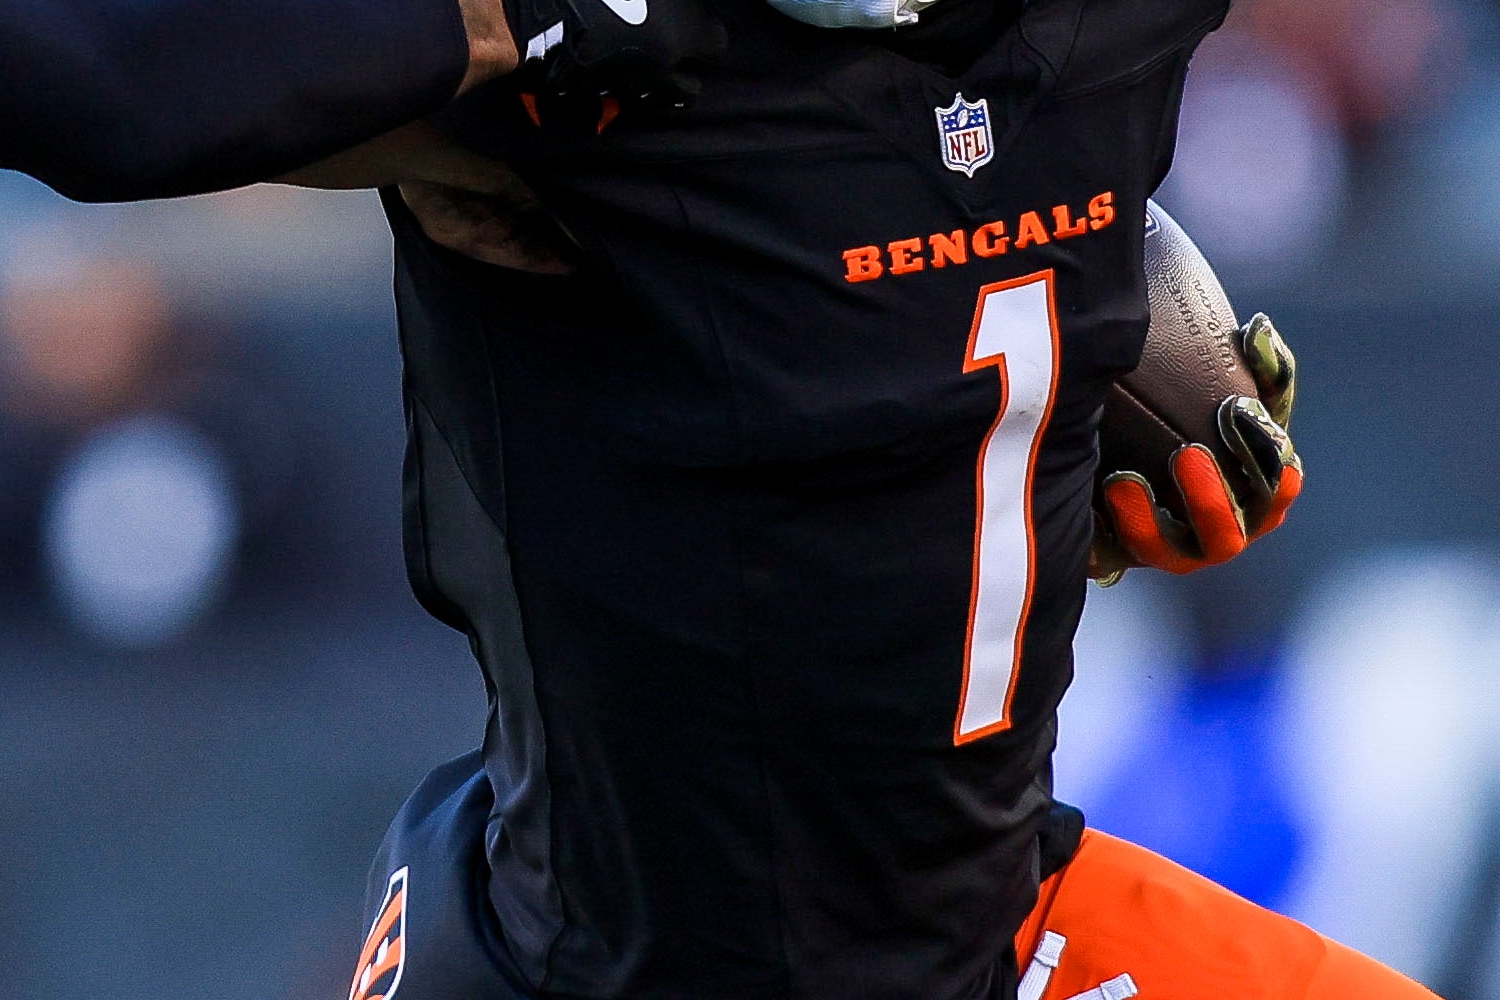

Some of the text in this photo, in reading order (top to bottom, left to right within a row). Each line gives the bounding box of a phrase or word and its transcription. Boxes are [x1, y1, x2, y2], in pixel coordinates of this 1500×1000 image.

[948, 130, 986, 162] NFL
[842, 191, 1115, 283] BENGALS
[953, 268, 1062, 746] 1
